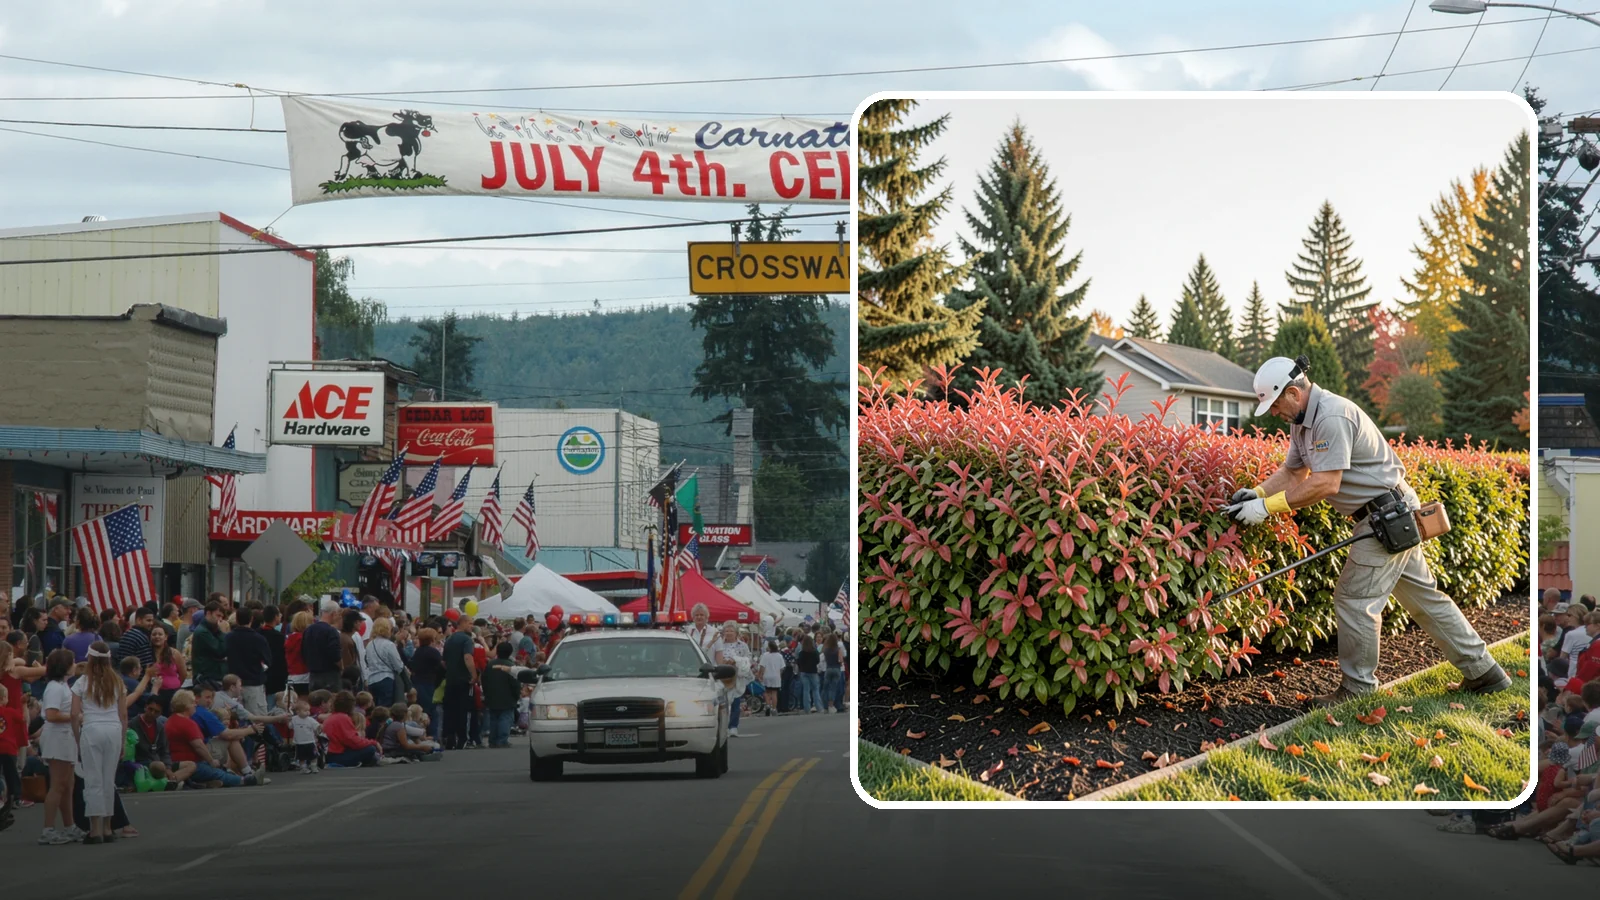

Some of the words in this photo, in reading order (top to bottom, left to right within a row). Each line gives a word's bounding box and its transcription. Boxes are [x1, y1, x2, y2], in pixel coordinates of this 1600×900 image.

[695, 121, 850, 149] Carnat
[481, 141, 605, 192] JULY
[632, 150, 746, 197] 4th.
[697, 254, 850, 279] CROSSWA
[282, 380, 373, 420] ACE
[405, 409, 453, 422] CEDAR
[283, 421, 371, 436] Hardware
[353, 468, 386, 479] Simpl
[95, 485, 124, 495] Vincent
[126, 486, 136, 495] de
[137, 486, 155, 495] Paul
[212, 516, 330, 535] HARDARE
[688, 526, 742, 535] CRNATION
[699, 535, 730, 543] GLASS
